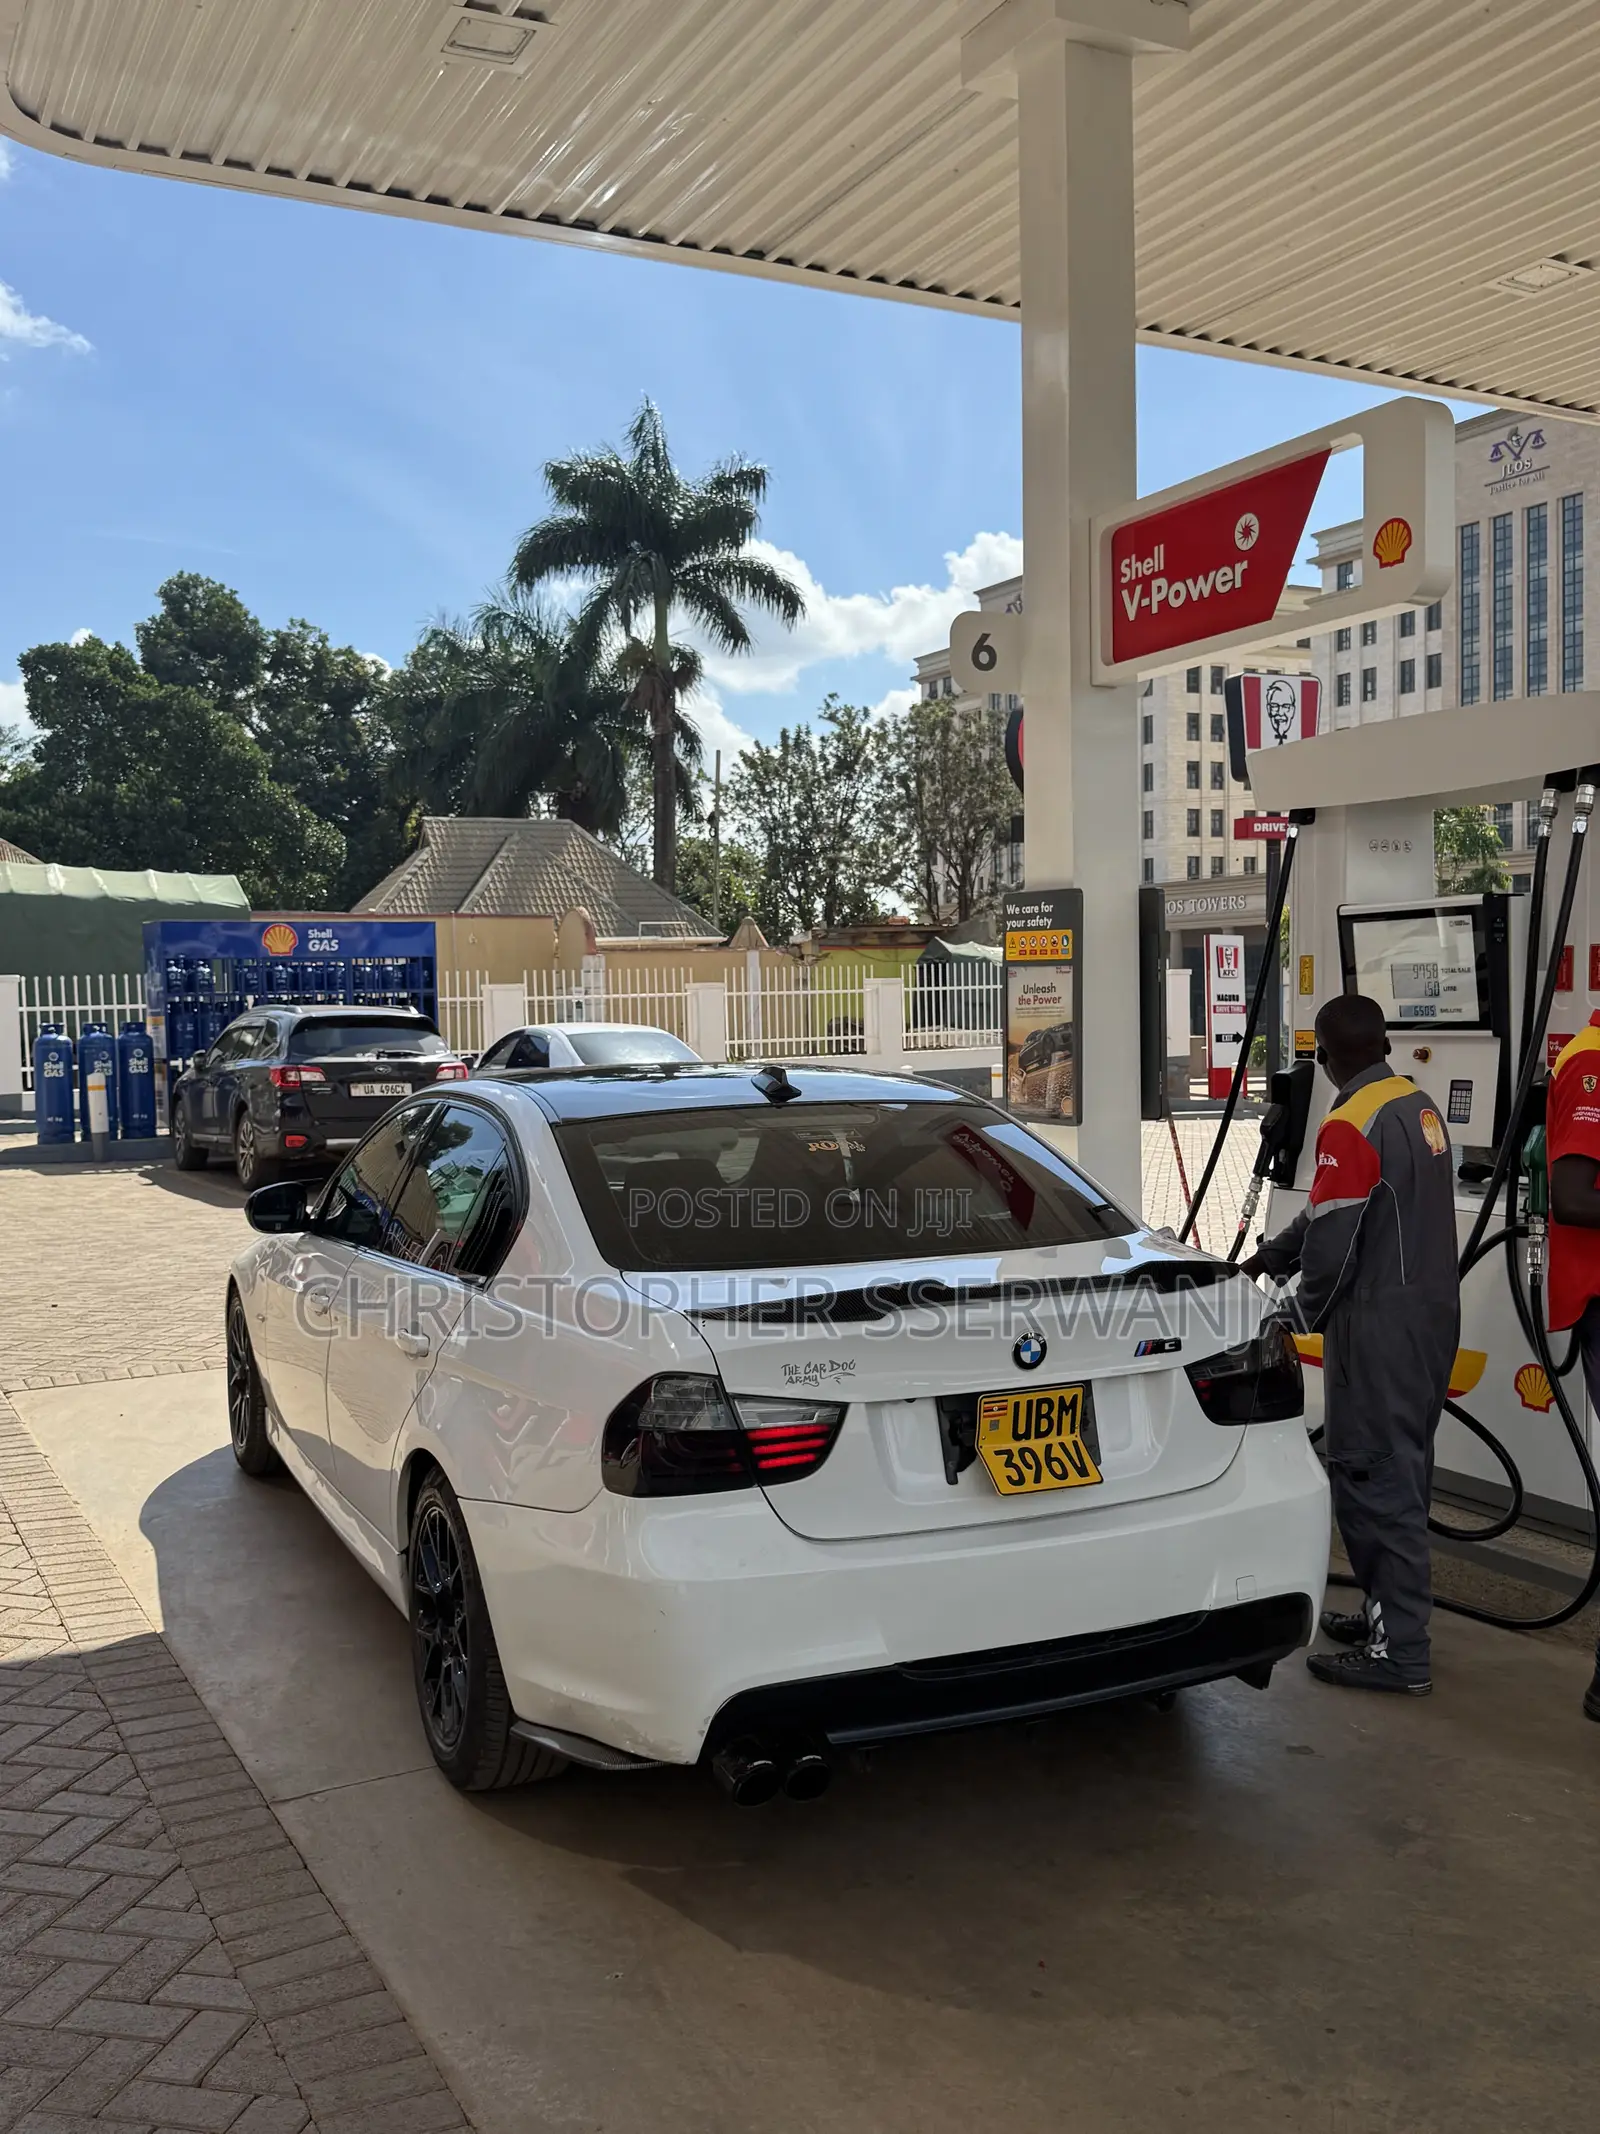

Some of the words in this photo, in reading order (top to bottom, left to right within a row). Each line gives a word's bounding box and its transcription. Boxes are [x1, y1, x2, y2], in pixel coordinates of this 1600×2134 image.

[1500, 458, 1533, 479] JLOS
[1120, 544, 1165, 584] Shell
[1121, 560, 1249, 622] V-Power
[971, 632, 998, 672] 6
[1253, 823, 1286, 832] DRIVE
[1006, 904, 1020, 915] We
[1021, 904, 1039, 914] care
[1040, 901, 1054, 913] for
[1165, 900, 1185, 915] OS
[1190, 895, 1246, 913] TOWERS
[1006, 920, 1025, 931] your
[1026, 915, 1053, 929] safety
[308, 929, 333, 939] Shell
[308, 939, 339, 952] GAS
[1222, 969, 1236, 977] KFC
[1022, 982, 1056, 994] Unleash
[1018, 994, 1032, 1005] the
[1033, 994, 1062, 1005] Power
[1215, 1005, 1230, 1013] DRIVE
[1413, 1005, 1436, 1017] 6505
[1221, 1034, 1234, 1042] EXIT
[43, 1062, 64, 1070] Shell
[94, 1060, 112, 1069] Shell
[129, 1058, 148, 1066] Shell
[43, 1069, 65, 1078] GAS
[128, 1065, 149, 1073] GAS
[364, 1084, 375, 1094] UA
[380, 1084, 406, 1094] 496CX
[781, 1363, 801, 1376] THE
[803, 1361, 826, 1376] CAR
[1011, 1394, 1079, 1441] UBM
[993, 1440, 1091, 1487] 396V
